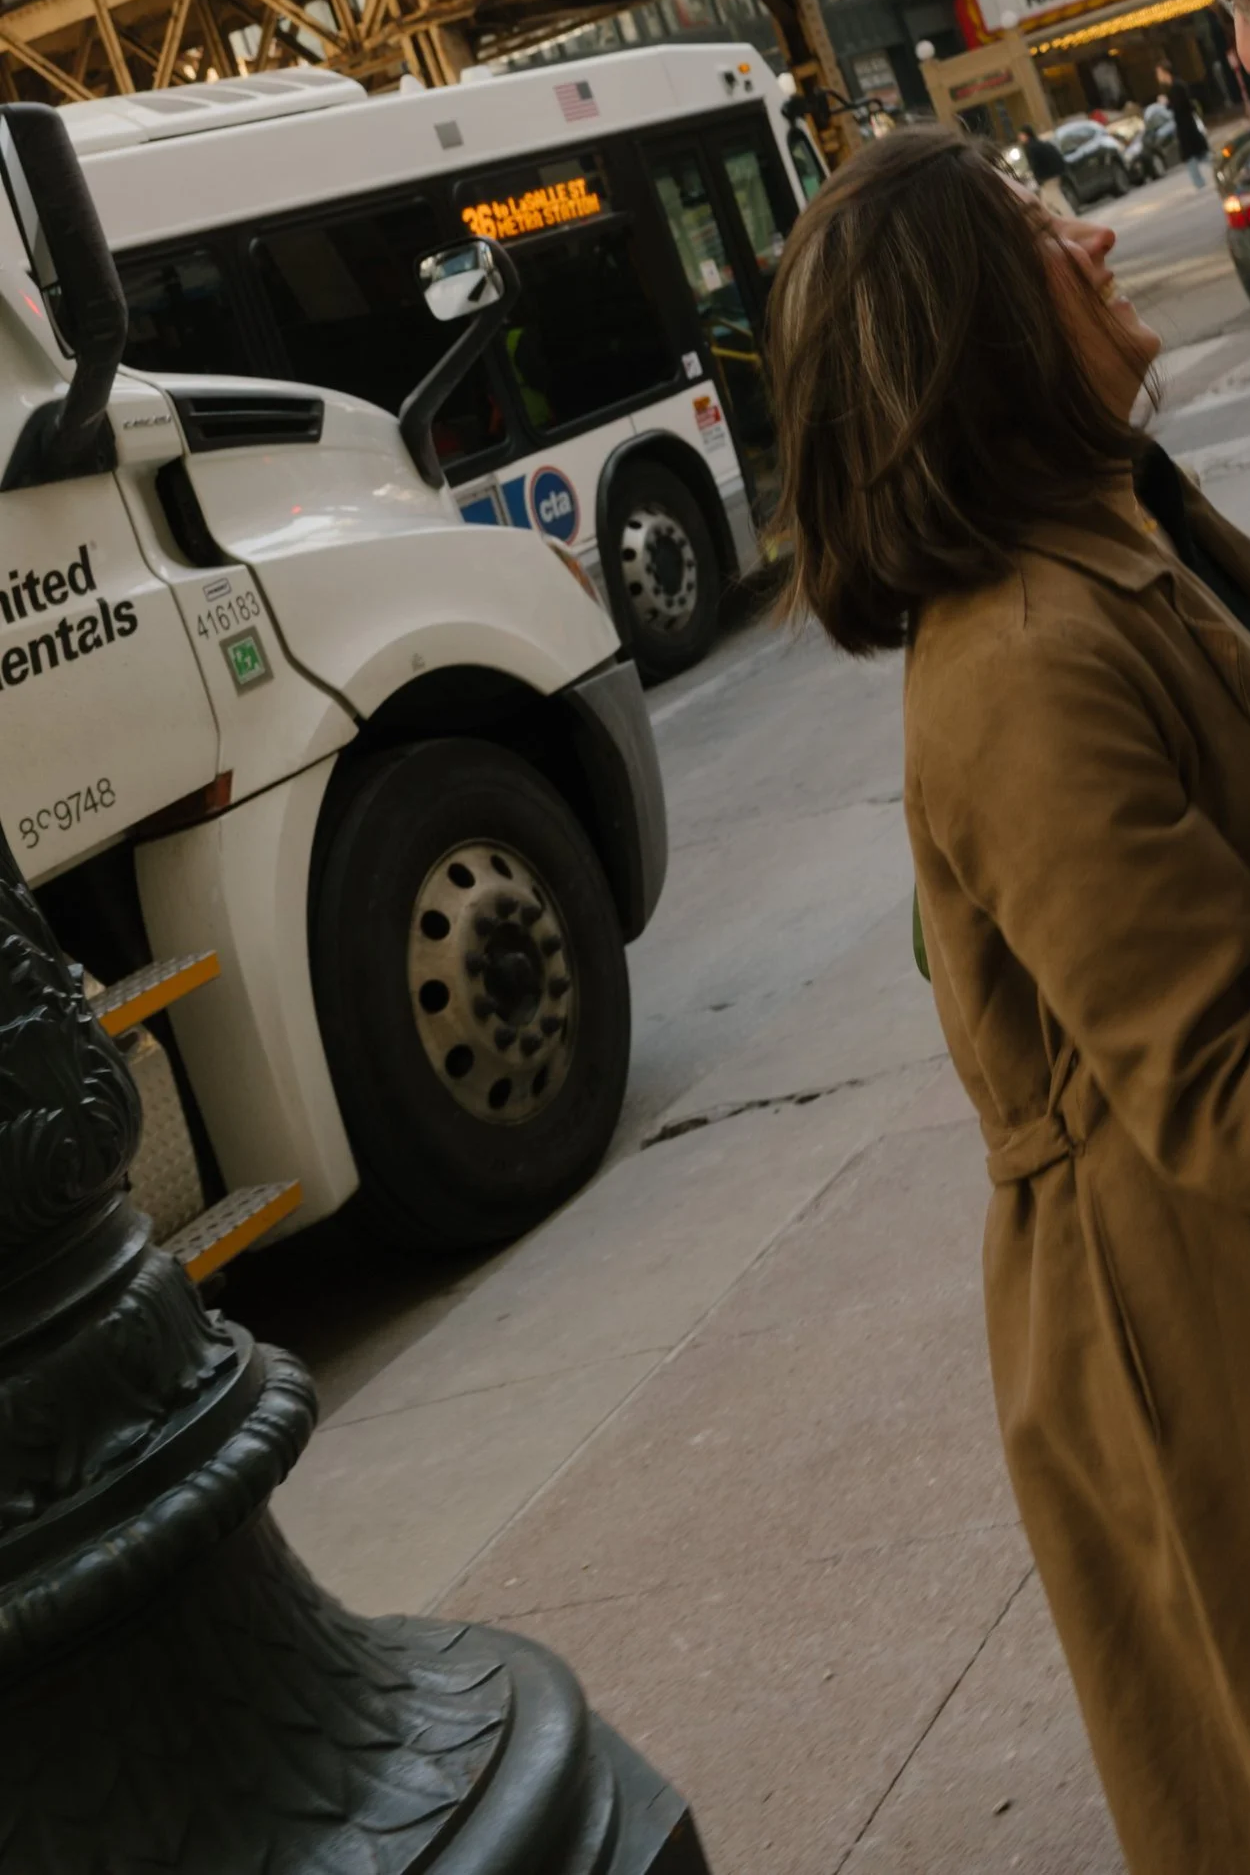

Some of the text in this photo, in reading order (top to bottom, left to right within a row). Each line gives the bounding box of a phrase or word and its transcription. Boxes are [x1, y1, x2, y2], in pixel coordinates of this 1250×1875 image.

[462, 203, 498, 240] 36
[540, 490, 572, 523] cta
[197, 591, 260, 640] 416183
[0, 597, 138, 692] entals
